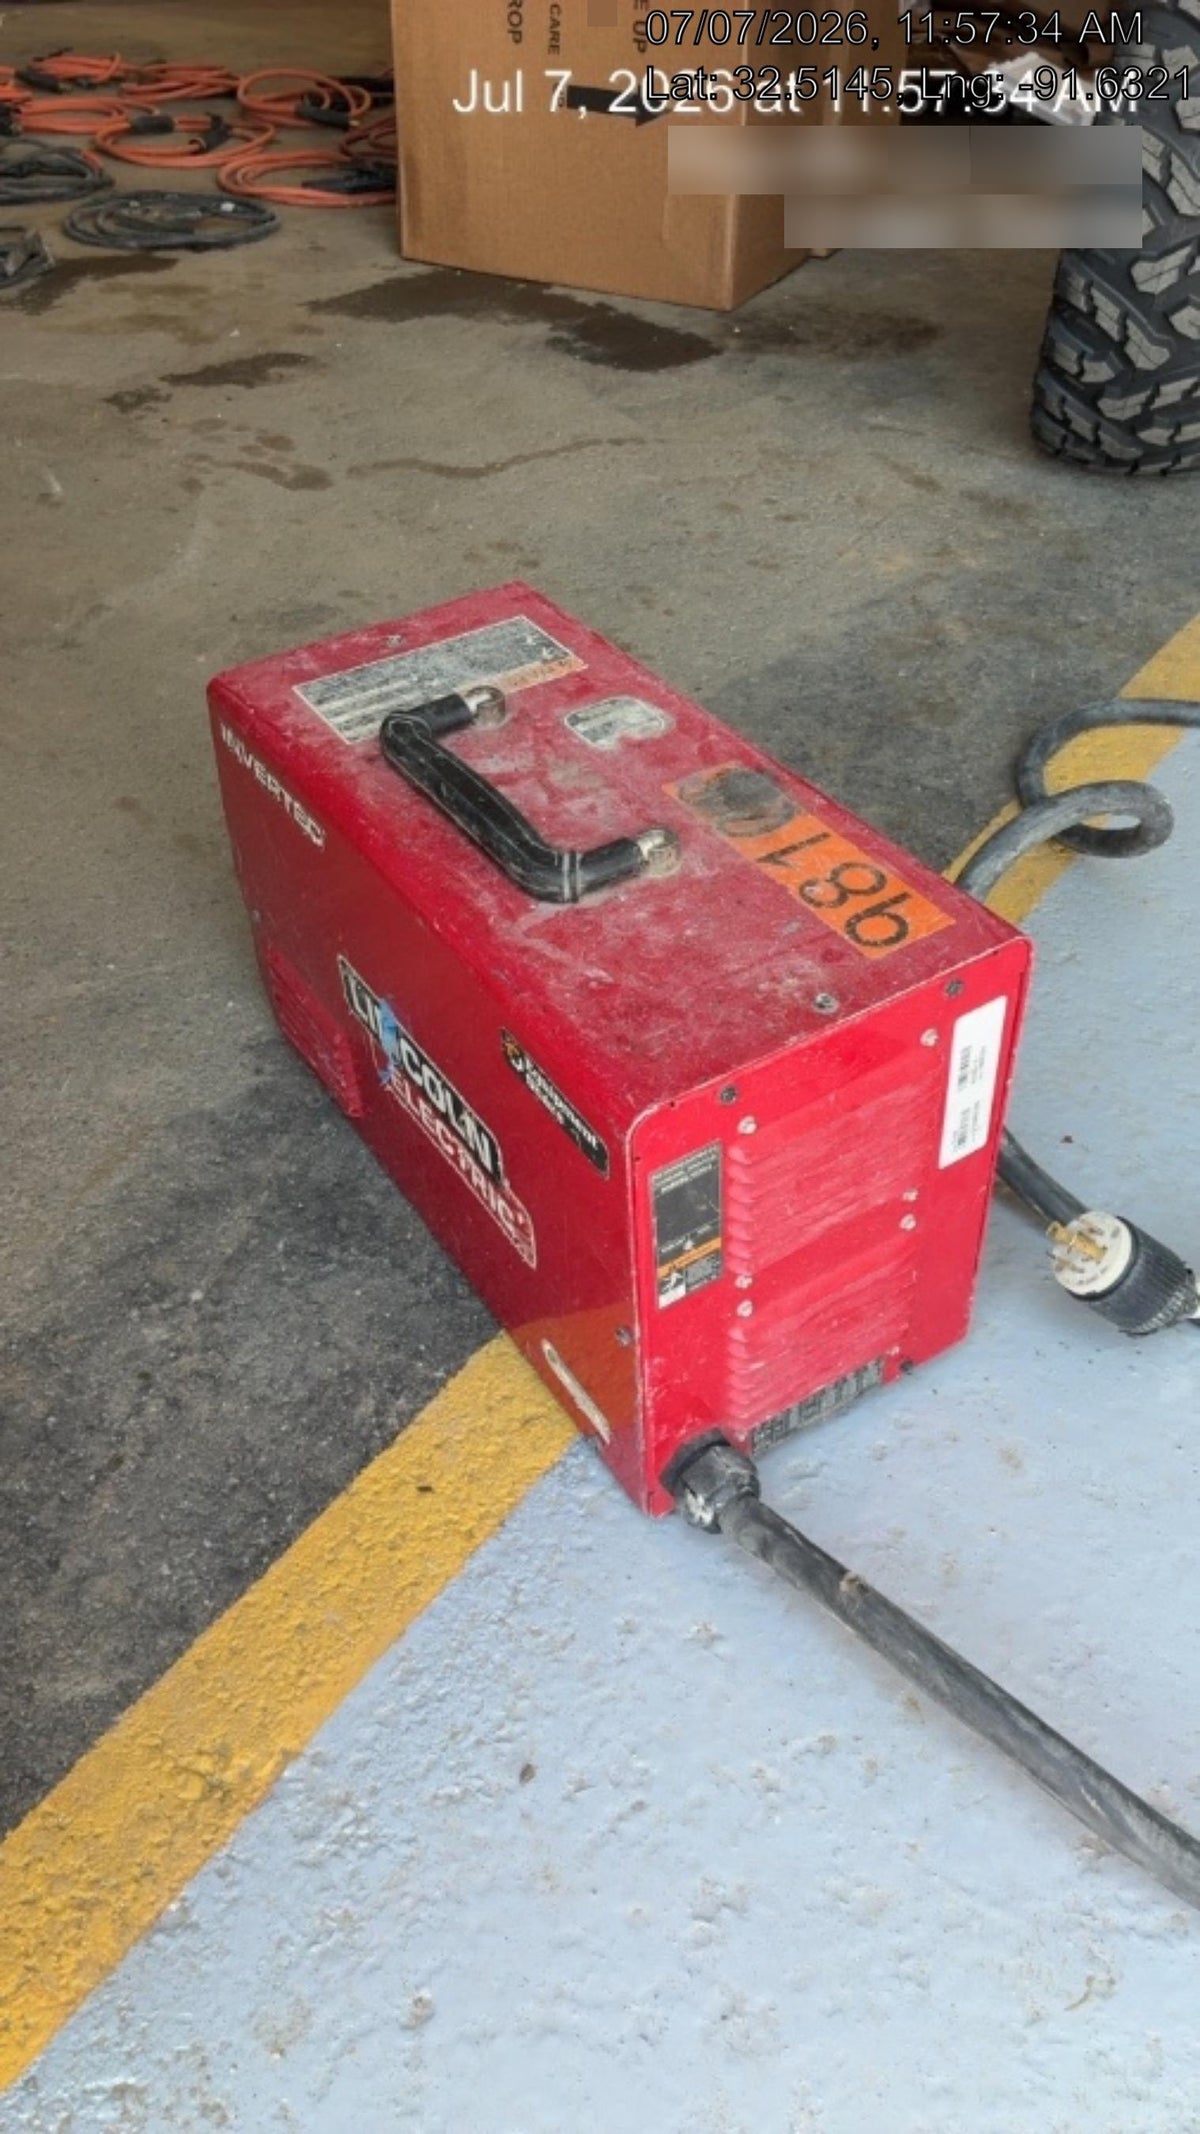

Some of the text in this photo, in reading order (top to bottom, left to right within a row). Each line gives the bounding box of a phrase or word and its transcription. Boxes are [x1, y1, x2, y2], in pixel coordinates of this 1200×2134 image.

[548, 3, 562, 55] CARE
[632, 20, 649, 53] UP
[388, 1070, 517, 1238] ELECTRIC
